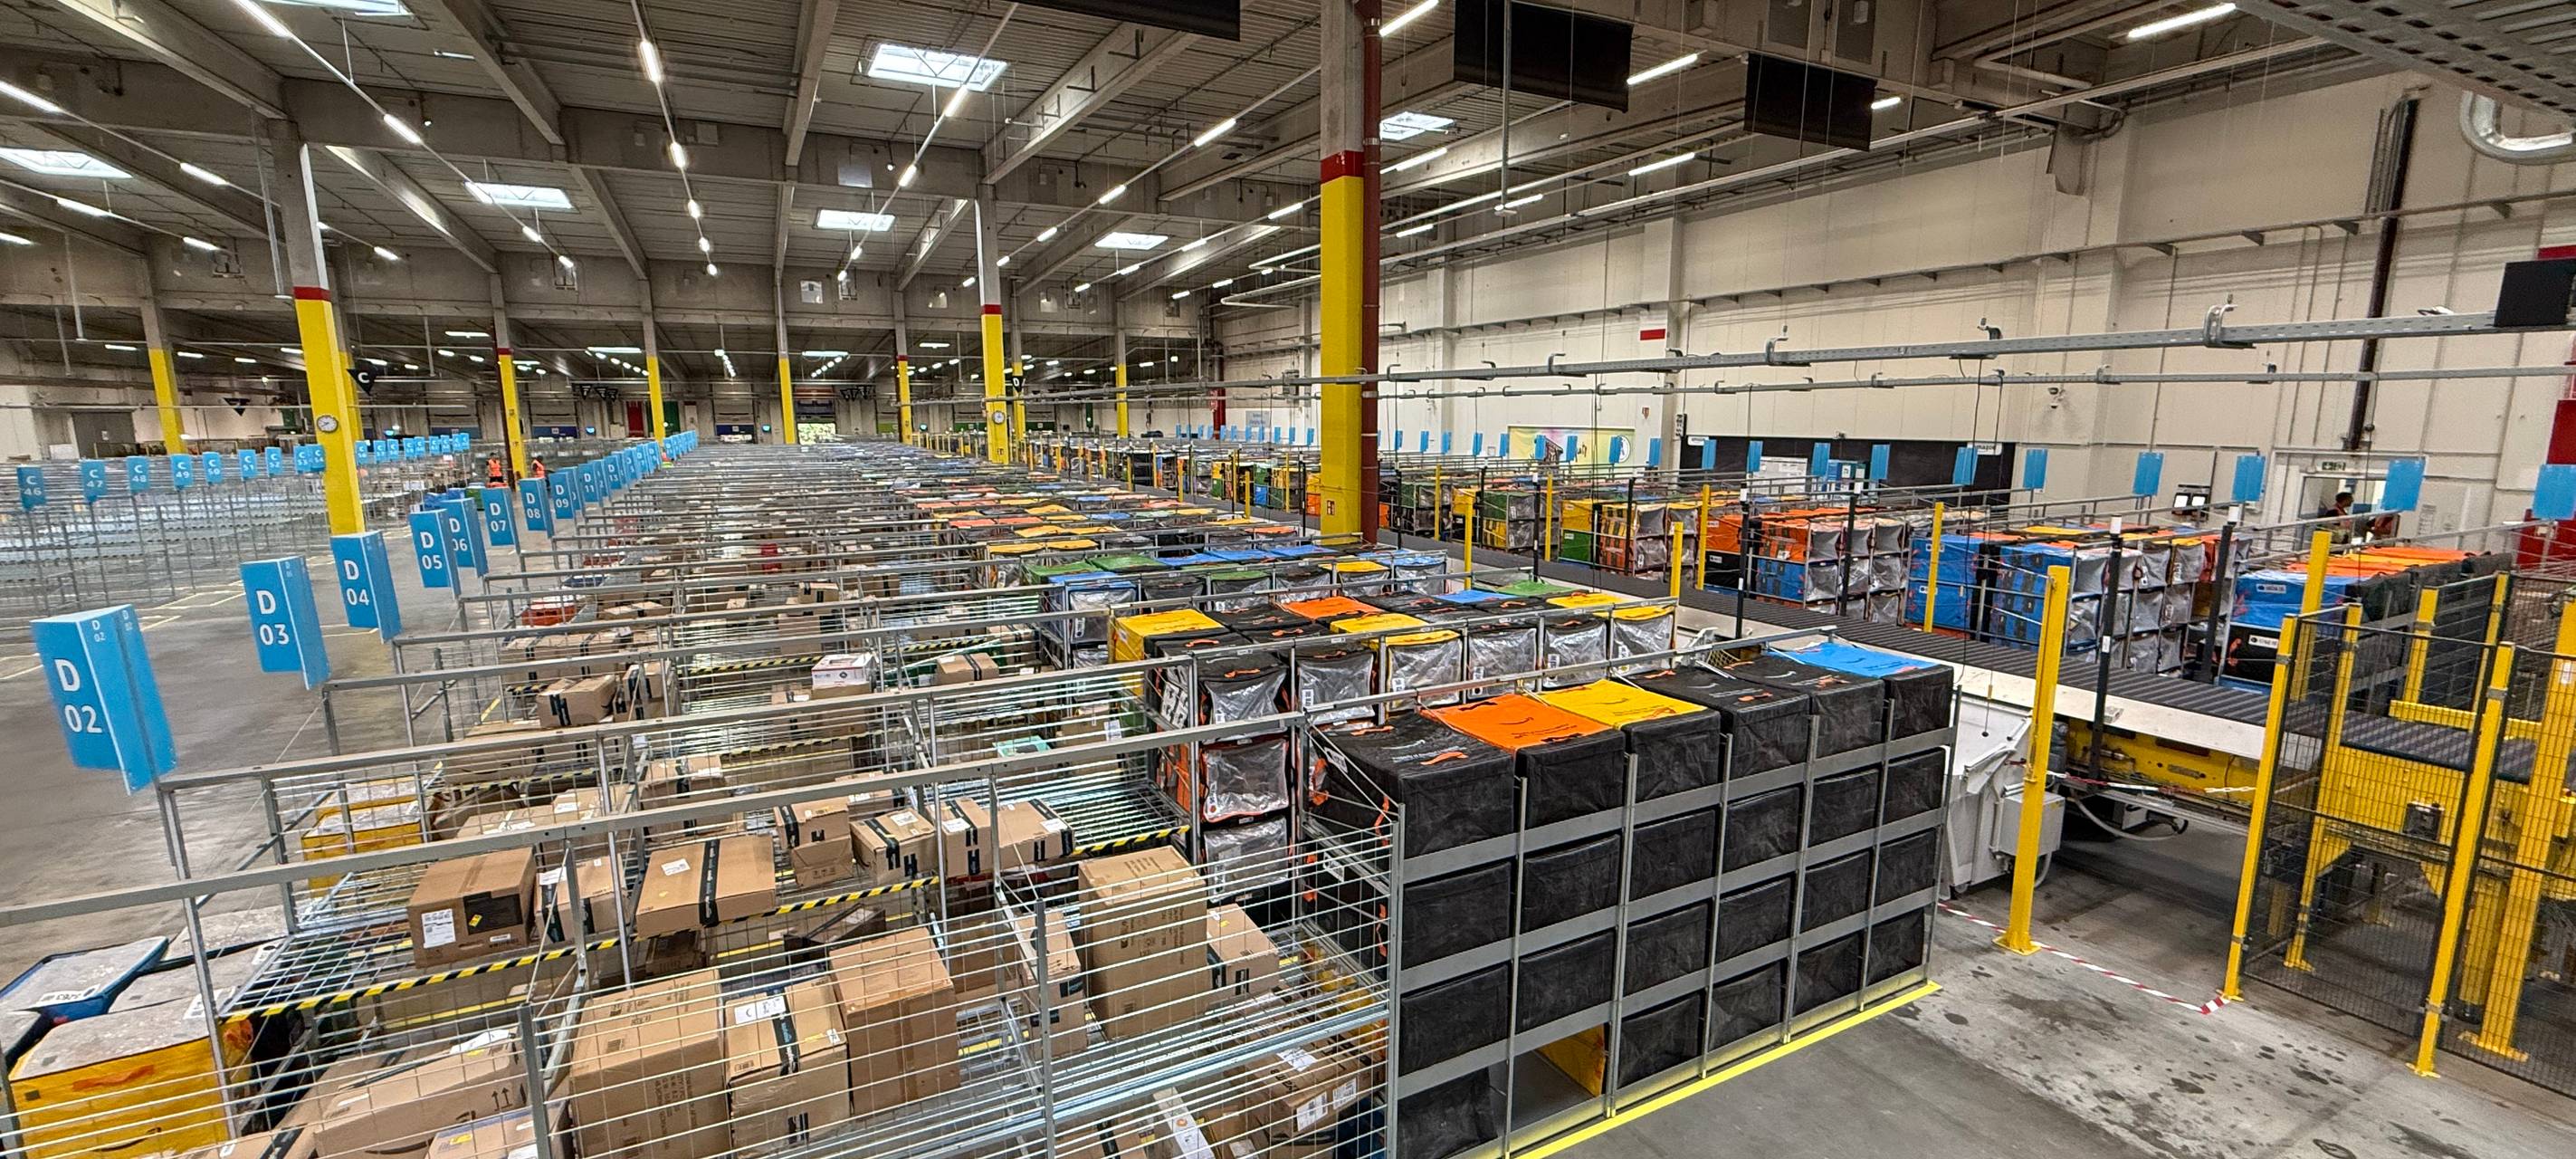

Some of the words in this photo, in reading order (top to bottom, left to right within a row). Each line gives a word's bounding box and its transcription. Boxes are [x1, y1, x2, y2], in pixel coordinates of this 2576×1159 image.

[358, 371, 370, 384] C
[1012, 377, 1020, 387] D
[244, 455, 253, 464] C
[271, 453, 278, 461] C
[177, 462, 186, 470] C
[208, 459, 216, 467] C
[608, 464, 615, 473] D
[90, 469, 99, 479] C
[134, 465, 143, 474] C
[176, 471, 190, 479] 49
[26, 475, 37, 485] C
[584, 473, 591, 483] D
[86, 480, 103, 488] 47
[555, 484, 565, 495] D
[585, 484, 595, 493] 11
[24, 487, 42, 496] 46
[526, 492, 536, 504] D
[556, 498, 569, 508] 09
[490, 503, 501, 516] D
[526, 508, 541, 519] 08
[449, 518, 461, 533] D
[491, 520, 507, 532] 07
[419, 532, 434, 549] D
[452, 538, 468, 551] 06
[421, 554, 443, 570] 05
[343, 560, 360, 580] D
[256, 589, 277, 615] D
[346, 588, 370, 607] 04
[122, 609, 129, 620] D
[91, 619, 100, 631] D
[94, 631, 106, 642] 02
[259, 623, 290, 646] 03
[54, 658, 81, 692] D
[64, 704, 103, 733] 02
